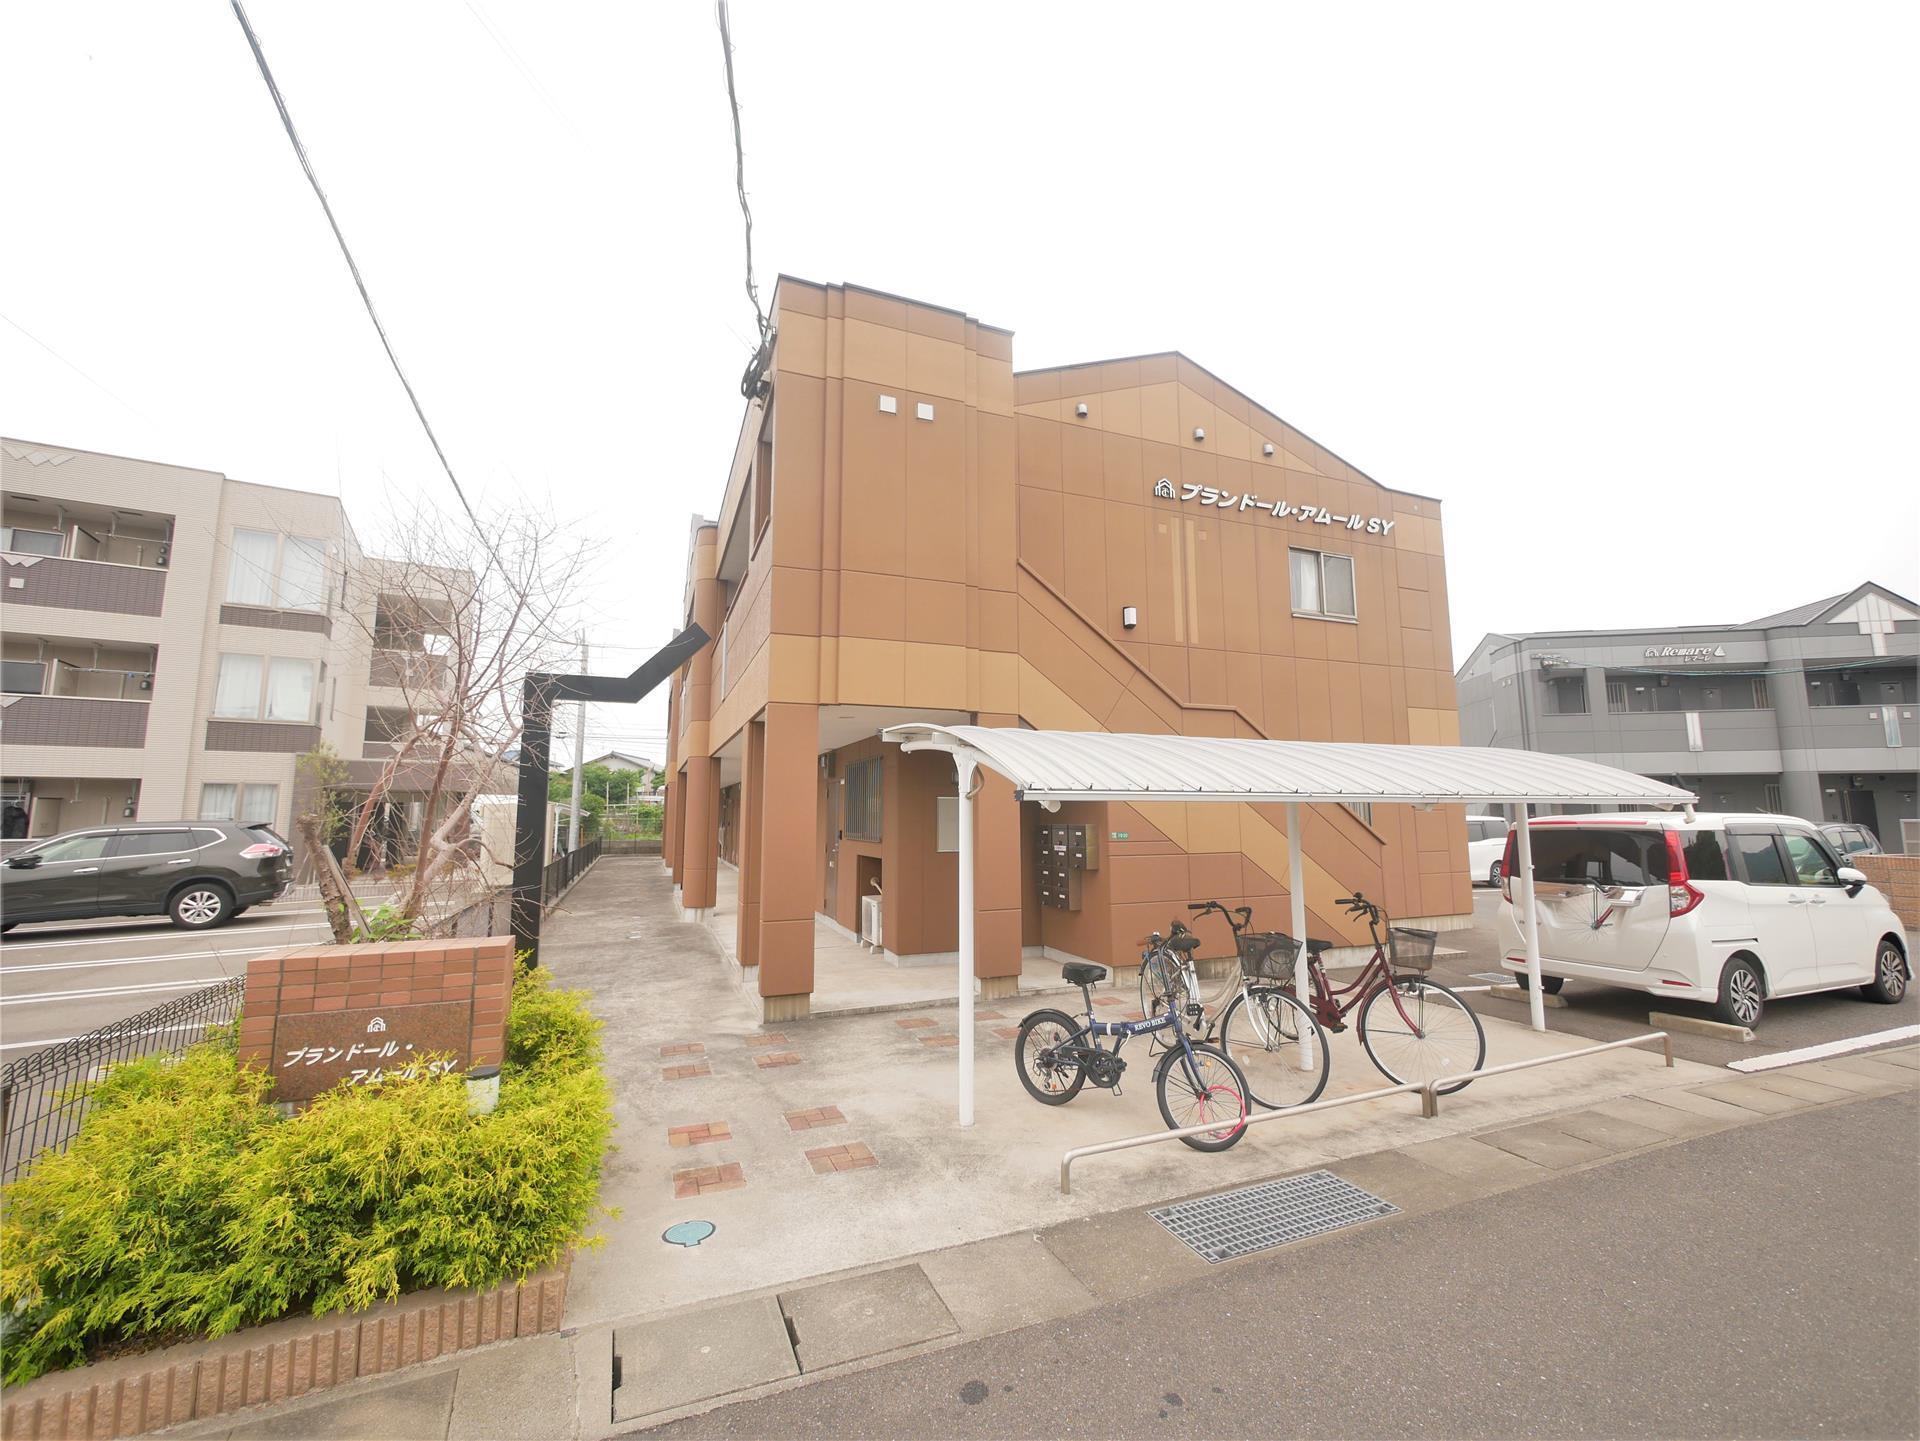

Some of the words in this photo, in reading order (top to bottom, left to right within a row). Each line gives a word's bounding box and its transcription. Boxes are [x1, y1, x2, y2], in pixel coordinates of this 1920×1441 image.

[1366, 517, 1395, 536] SY
[1661, 646, 1712, 656] Remare
[1134, 1021, 1151, 1031] REVO
[1151, 1016, 1167, 1026] BIKE
[428, 1059, 458, 1078] SY
